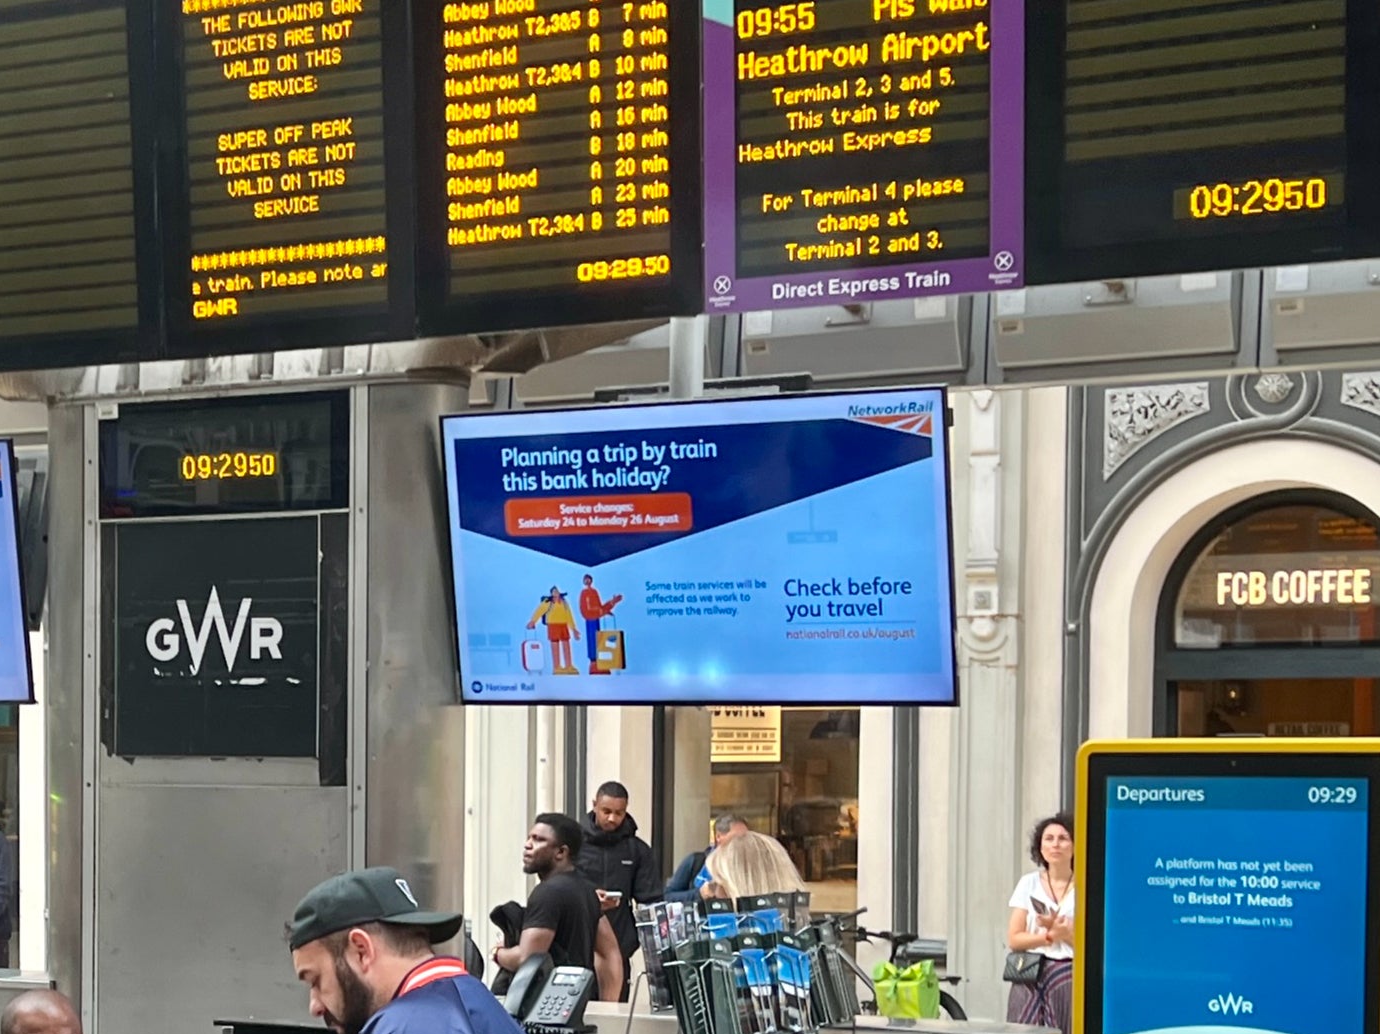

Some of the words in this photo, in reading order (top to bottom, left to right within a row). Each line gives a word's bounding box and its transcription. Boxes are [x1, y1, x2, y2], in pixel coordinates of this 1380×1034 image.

[202, 14, 232, 34] THE
[236, 1, 326, 29] FOLLOWING
[329, 0, 363, 16] GWR
[444, 25, 518, 48] Heathrow
[525, 12, 582, 36] T2,3&5
[588, 8, 600, 27] B
[623, 3, 633, 23] 7
[640, 1, 667, 20] min
[737, 2, 817, 40] 09:55
[872, 0, 916, 22] Pls
[212, 31, 278, 56] TICKETS
[284, 25, 316, 47] ARE
[320, 19, 353, 41] NOT
[445, 46, 518, 73] Shenfield
[589, 34, 600, 52] A
[623, 29, 634, 48] 8
[640, 26, 668, 46] min
[738, 43, 870, 80] Heathrow
[879, 22, 989, 64] Airport
[224, 57, 272, 79] VALID
[274, 54, 299, 72] ON
[306, 47, 342, 67] THIS
[248, 75, 317, 100] SERVICE:
[772, 80, 849, 106] Terminal
[854, 78, 874, 98] 2,
[880, 75, 892, 94] 3
[899, 70, 933, 92] and
[937, 67, 954, 86] 5.
[787, 111, 824, 129] This
[831, 105, 879, 126] train
[882, 104, 900, 121] is
[906, 99, 940, 116] for
[217, 129, 268, 152] SUPER
[273, 125, 305, 145] OFF
[311, 119, 352, 139] PEAK
[739, 138, 835, 162] Heathrow
[841, 127, 932, 152] Express
[772, 277, 824, 300] Direct
[828, 274, 900, 297] Express
[904, 269, 950, 289] Train
[193, 297, 239, 318] GWR
[501, 446, 583, 470] Planning
[586, 450, 600, 464] a
[602, 444, 637, 466] trip
[640, 442, 666, 465] by
[670, 439, 718, 460] train
[502, 471, 538, 492] this
[541, 469, 588, 490] bank
[592, 465, 670, 491] holiday?
[518, 518, 560, 530] Saturday
[562, 517, 575, 527] 24
[576, 517, 587, 527] to
[589, 515, 628, 528] Monday
[630, 516, 643, 525] 26
[645, 514, 679, 527] August
[559, 503, 592, 515] Service
[645, 582, 671, 591] Some
[673, 581, 695, 590] train
[698, 581, 734, 590] services
[737, 580, 753, 589] will
[755, 579, 767, 589] be
[646, 594, 684, 603] affected
[699, 595, 713, 603] we
[715, 594, 737, 602] work
[740, 594, 750, 602] to
[784, 578, 844, 597] Check
[848, 576, 912, 596] before
[1217, 571, 1267, 605] FCB
[1271, 569, 1371, 604] COFFEE
[647, 607, 684, 618] improve
[686, 606, 701, 615] the
[785, 602, 821, 620] you
[827, 598, 883, 617] travel
[146, 584, 283, 676] GWR
[786, 627, 916, 641] nationalrail.co.uk/august
[1117, 785, 1205, 804] Departures
[1308, 787, 1357, 803] 09:29
[1155, 858, 1163, 868] A
[1166, 858, 1215, 871] platform
[1217, 860, 1238, 871] has
[1240, 860, 1259, 871] not
[1263, 861, 1281, 874] yet
[1284, 861, 1313, 872] been
[1147, 876, 1196, 888] assigned
[1199, 876, 1215, 887] for
[1218, 876, 1236, 887] the
[1240, 876, 1278, 888] 10:00
[1281, 878, 1321, 890] service
[1173, 894, 1185, 904] to
[1188, 892, 1231, 905] Bristol
[1235, 894, 1244, 905] T
[1247, 894, 1293, 907] Meads
[1208, 993, 1253, 1015] GWR
